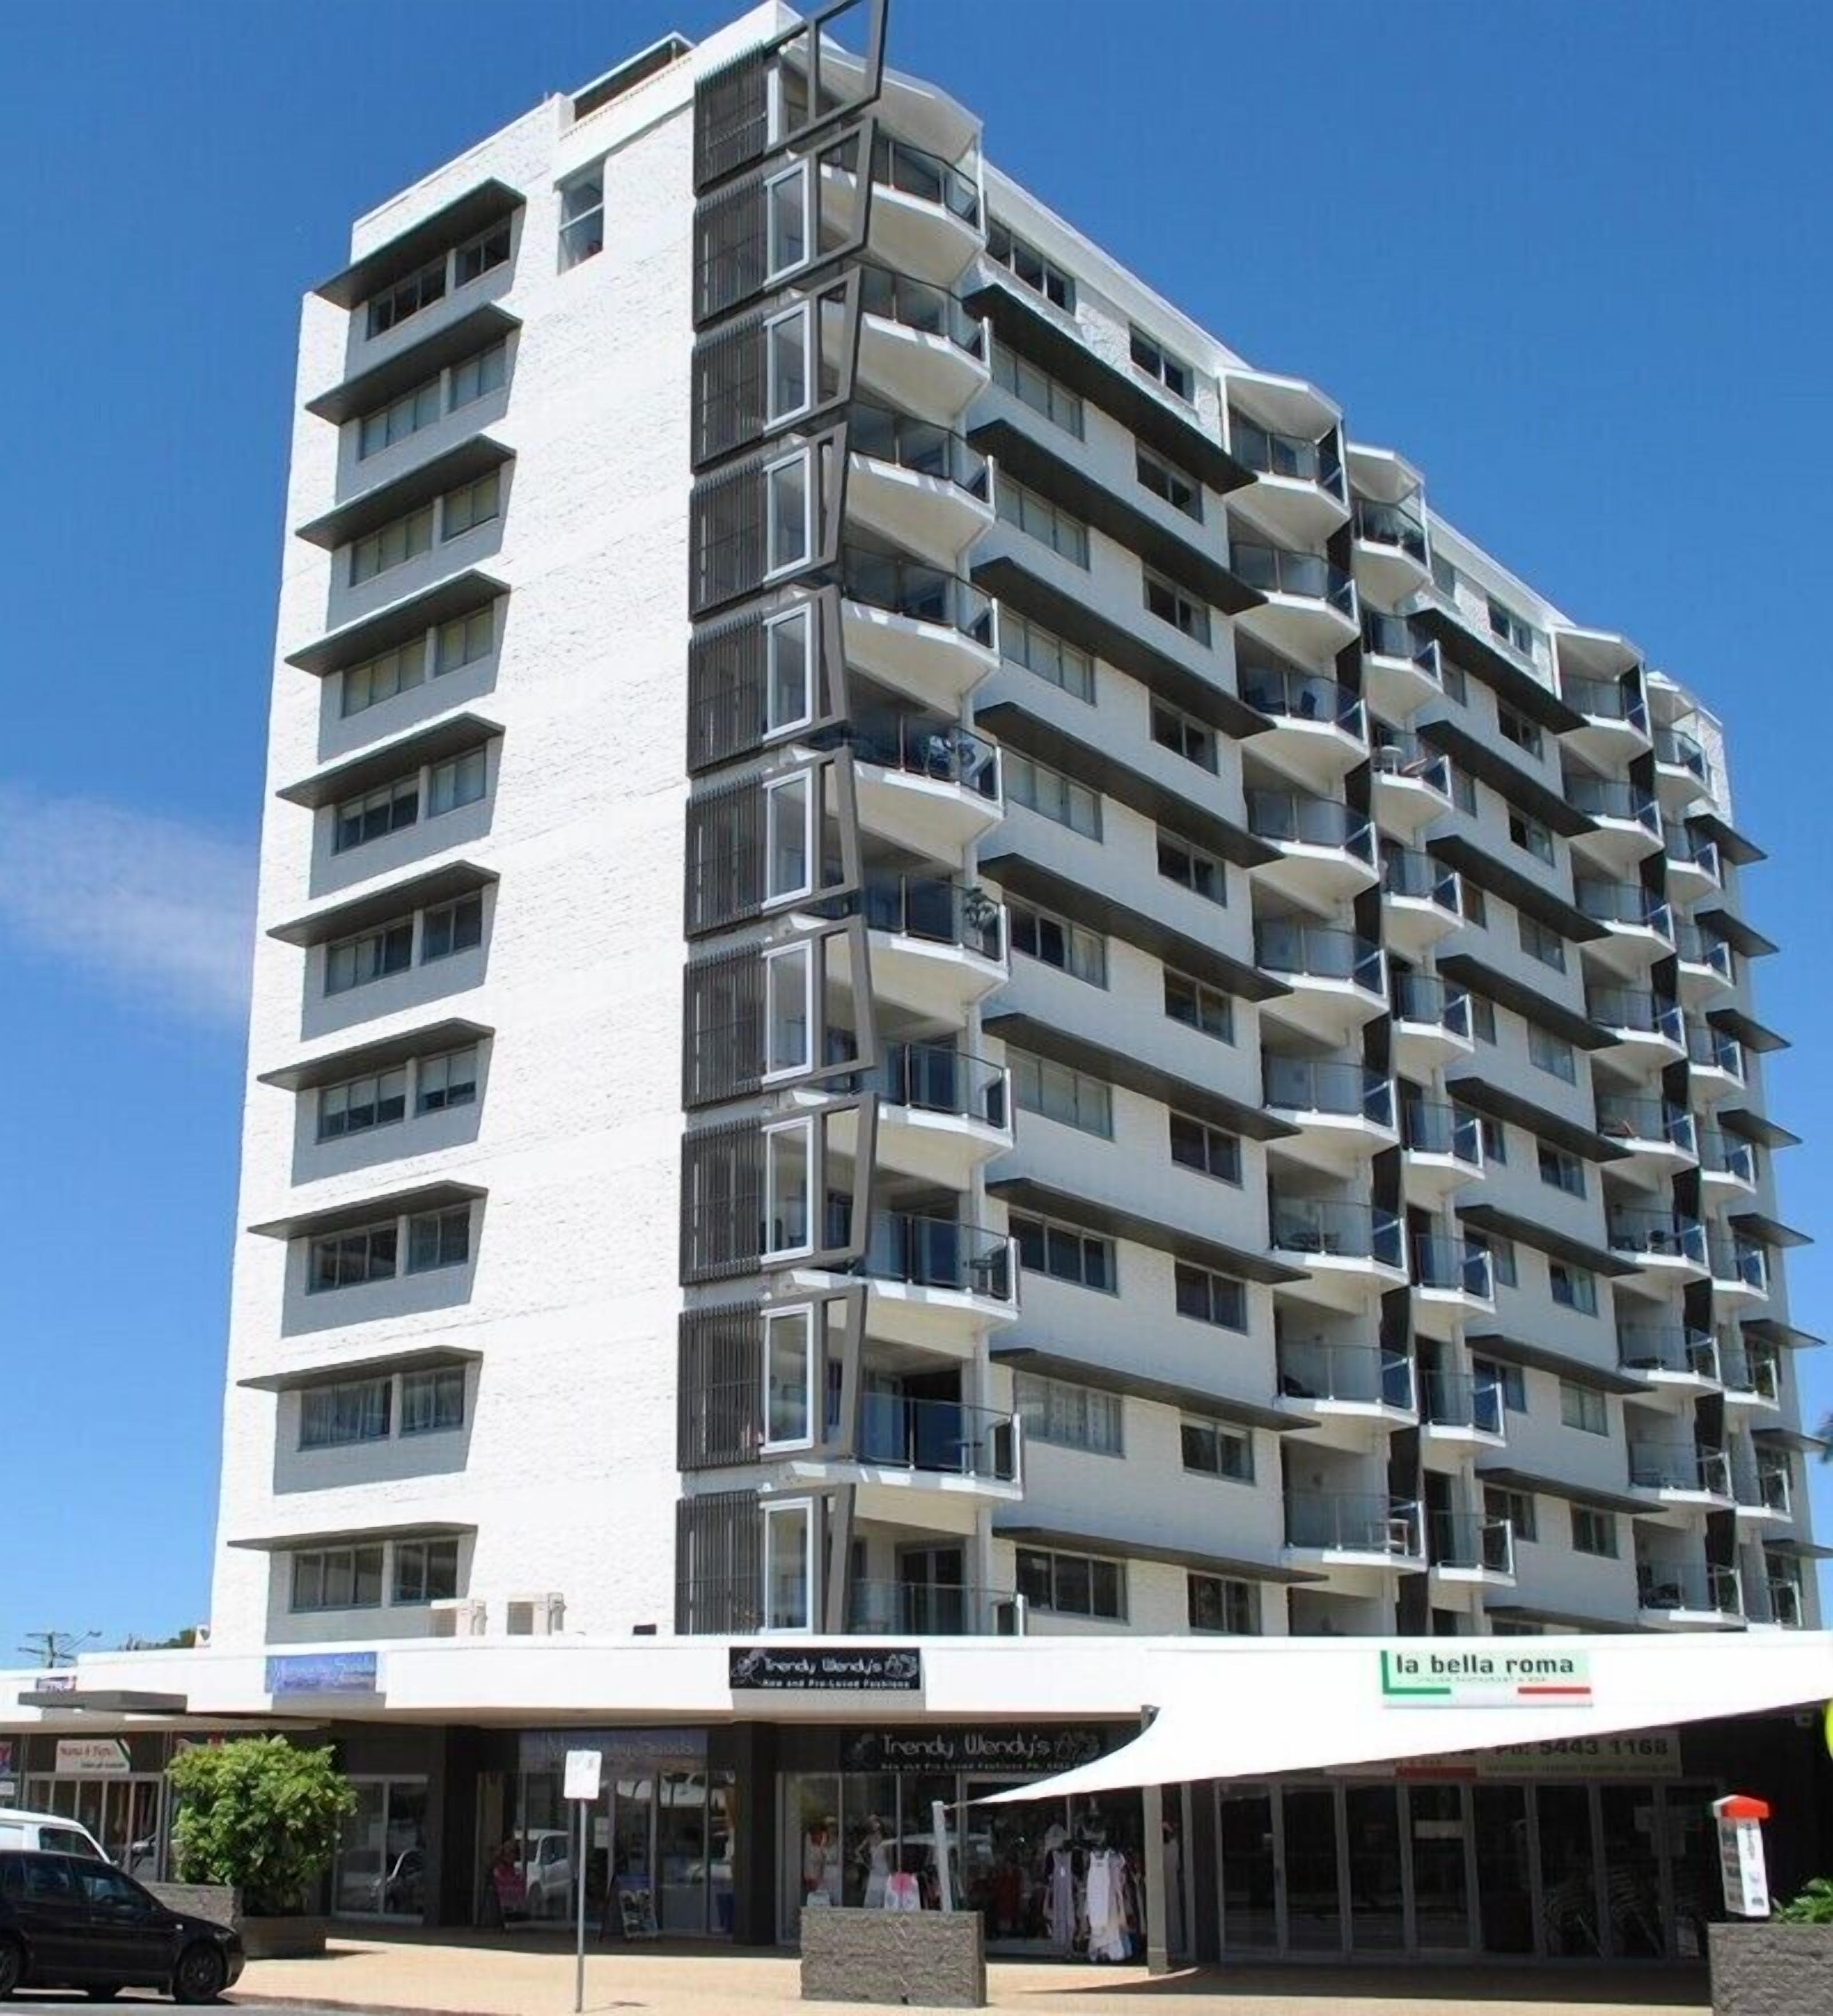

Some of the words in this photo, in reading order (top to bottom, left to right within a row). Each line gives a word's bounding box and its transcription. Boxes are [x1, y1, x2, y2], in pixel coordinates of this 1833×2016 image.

[765, 1657, 816, 1675] Trendy
[823, 1657, 883, 1676] Wendy's
[1397, 1654, 1419, 1674] la
[1431, 1654, 1494, 1674] bella
[1505, 1658, 1575, 1674] roma
[882, 1733, 954, 1759] Trendy
[964, 1732, 1050, 1759] Wendy's
[1540, 1738, 1599, 1755] 5443
[1608, 1738, 1669, 1755] 1168
